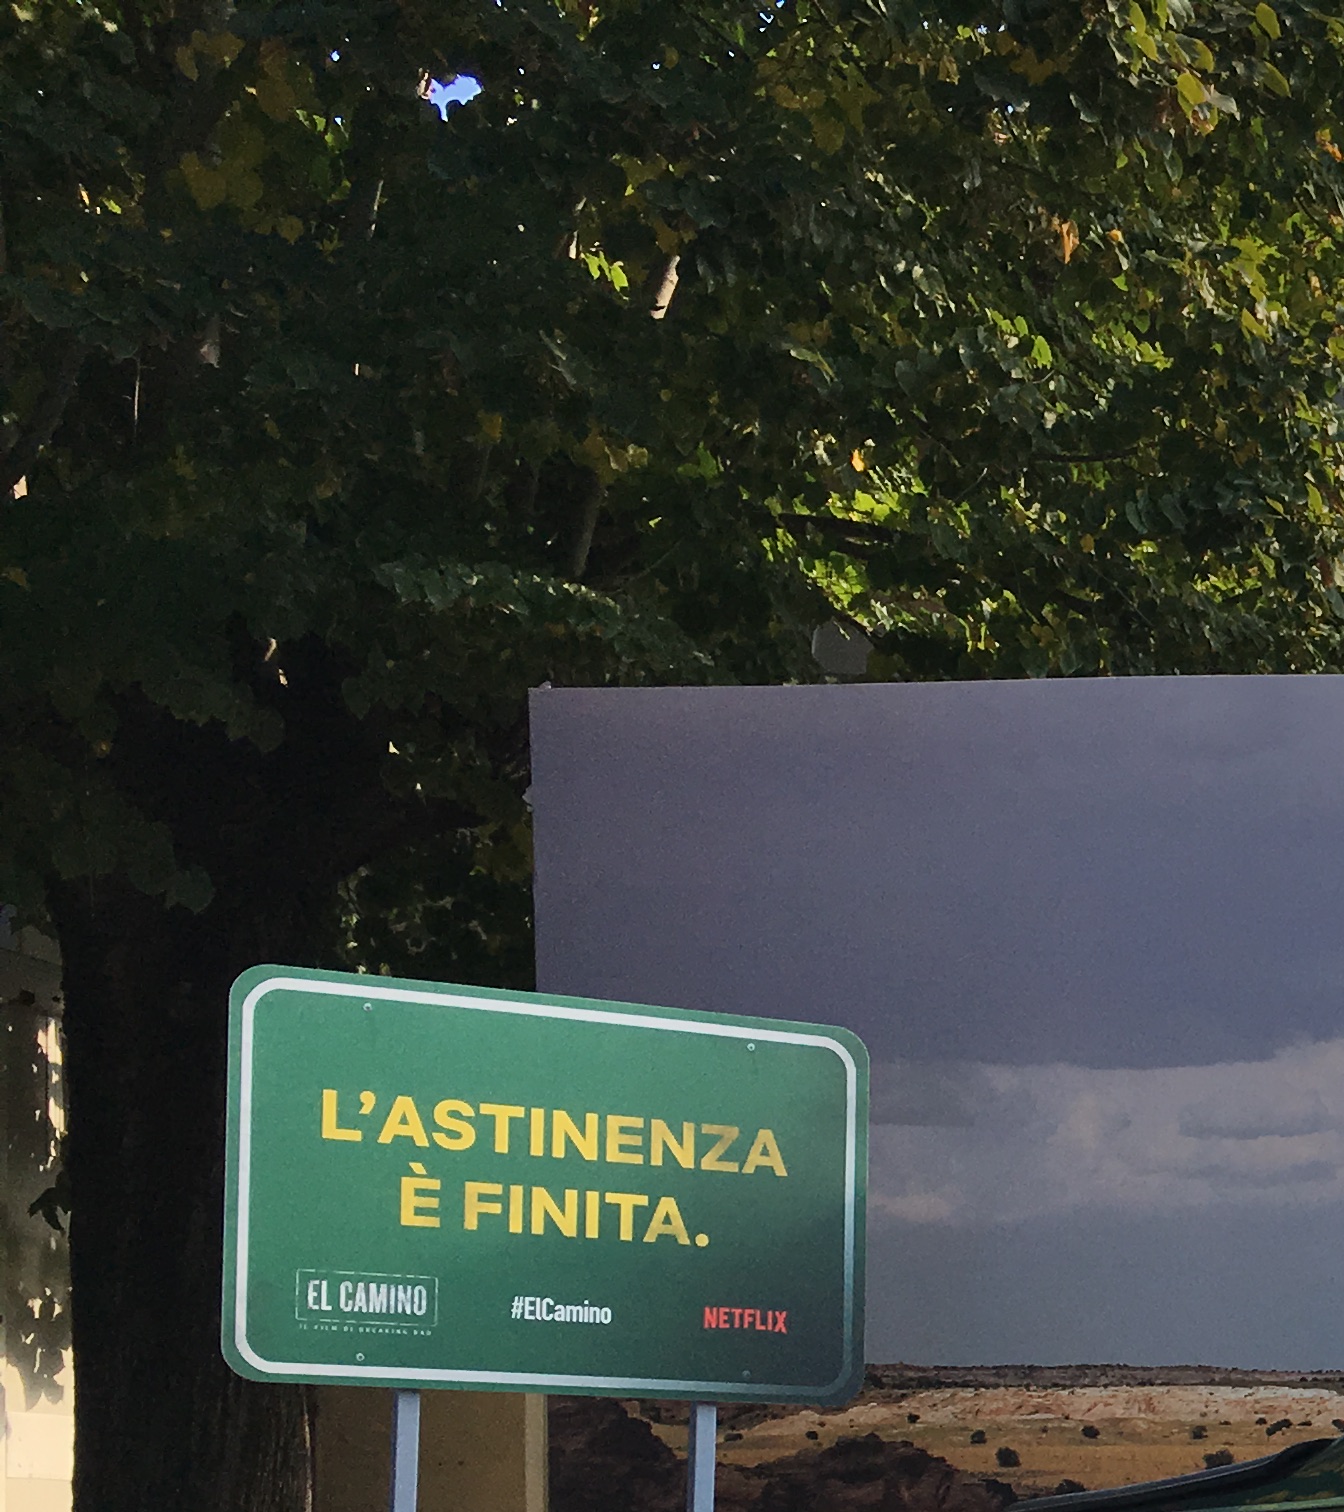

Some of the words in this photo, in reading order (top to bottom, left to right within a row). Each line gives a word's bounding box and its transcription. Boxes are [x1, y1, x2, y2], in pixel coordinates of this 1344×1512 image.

[321, 1088, 788, 1177] L'ASTINENZA
[401, 1162, 441, 1228] È
[463, 1180, 710, 1248] FINITA.
[307, 1279, 333, 1311] EL
[339, 1280, 427, 1316] CAMINO
[510, 1295, 612, 1325] #ElCamino
[703, 1306, 788, 1334] NETFLIX
